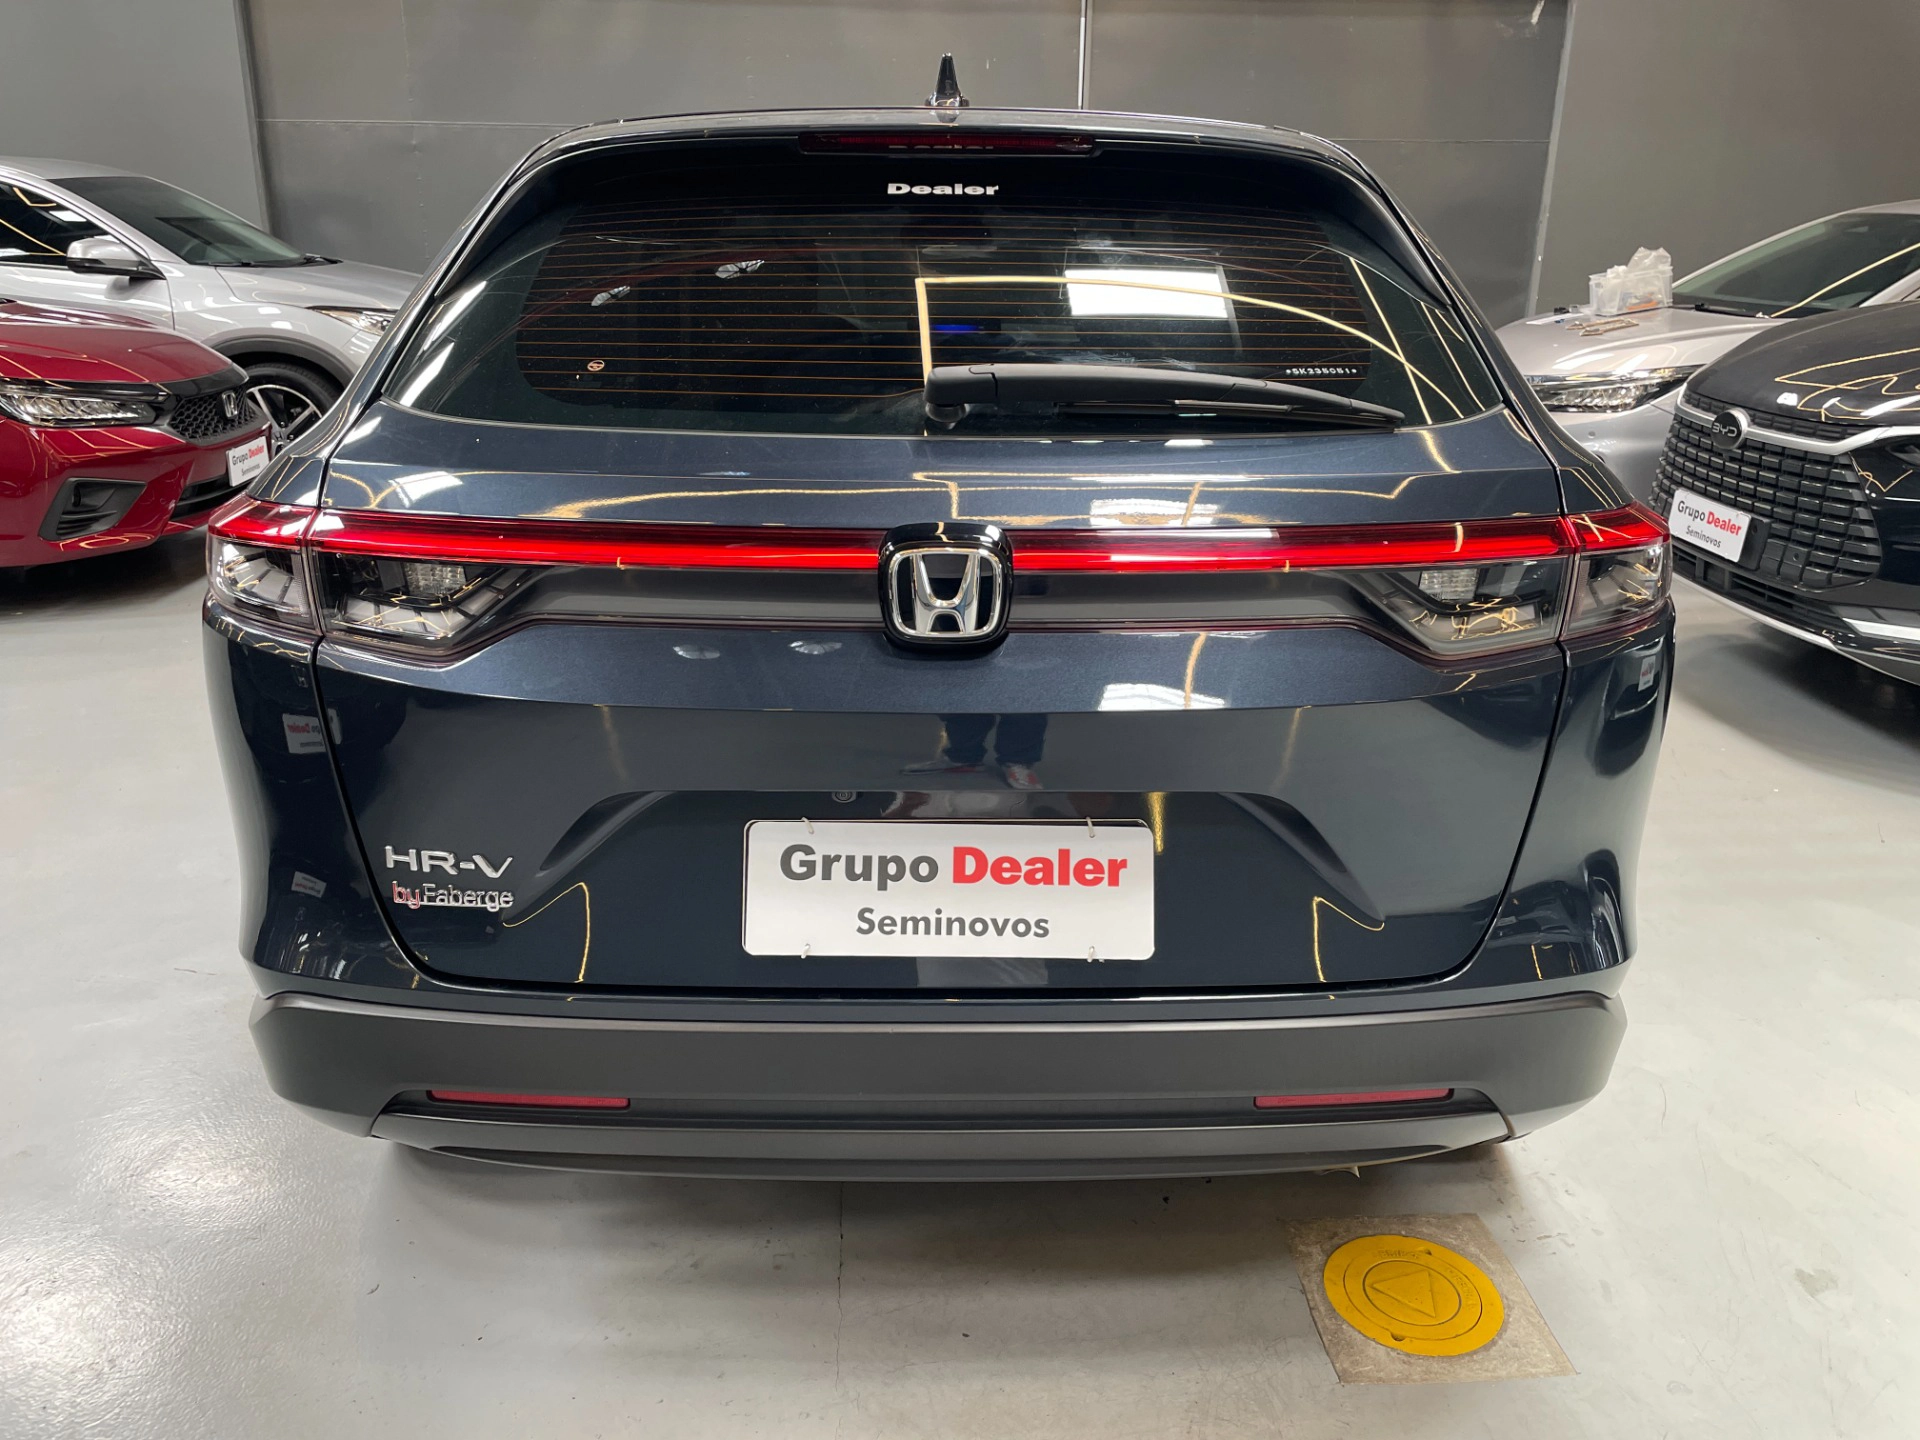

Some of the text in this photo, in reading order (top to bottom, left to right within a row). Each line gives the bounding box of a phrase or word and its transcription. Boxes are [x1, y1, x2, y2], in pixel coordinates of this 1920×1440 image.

[886, 183, 999, 195] Dealer
[1711, 422, 1738, 437] BYD
[1677, 500, 1742, 536] Grupo Dealer
[1685, 525, 1722, 548] Seminovos
[384, 845, 513, 879] HR-V
[779, 843, 1128, 892] Grupo Dealer
[855, 906, 1051, 939] Seminovos
